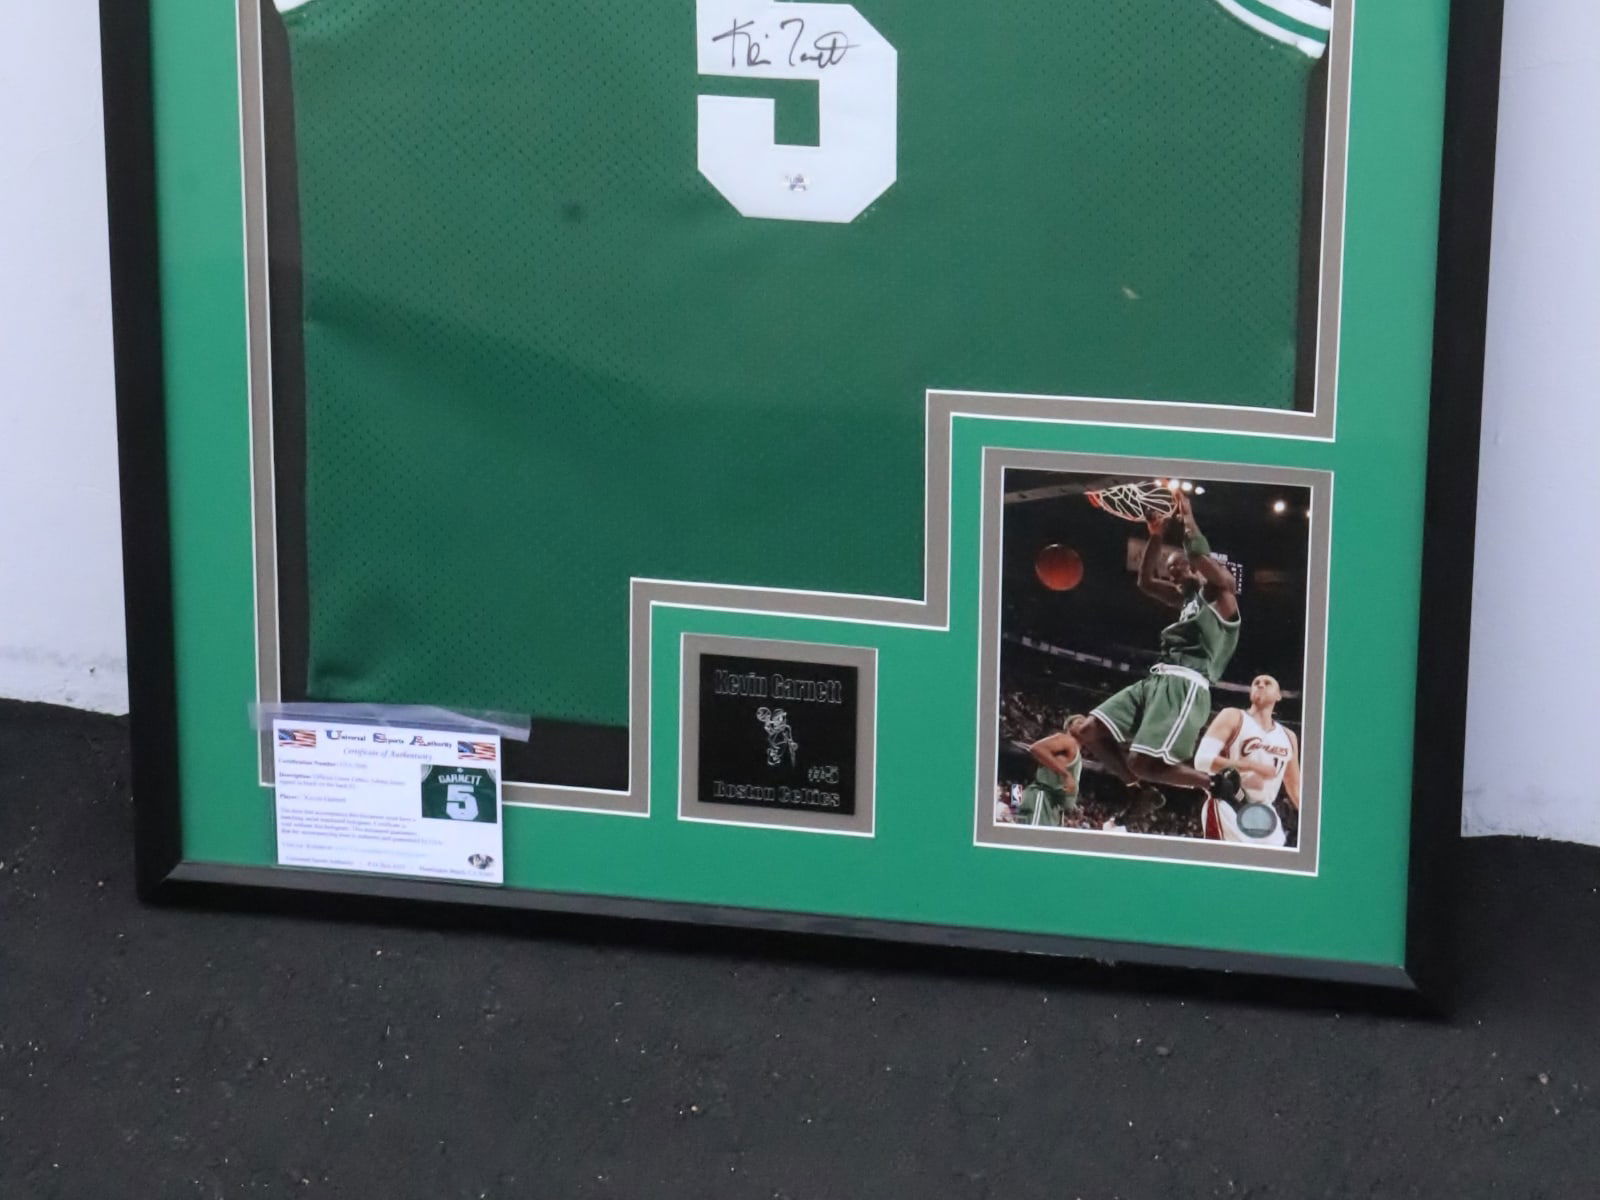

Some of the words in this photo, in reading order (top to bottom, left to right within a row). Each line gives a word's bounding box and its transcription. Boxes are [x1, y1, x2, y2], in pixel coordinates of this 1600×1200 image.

[713, 669, 768, 698] Kevin
[771, 673, 842, 704] Garnett
[326, 730, 366, 741] Universal
[438, 774, 482, 786] GARNETT
[713, 780, 774, 802] Boston
[779, 786, 841, 807] Celtics
[446, 784, 479, 820] 5
